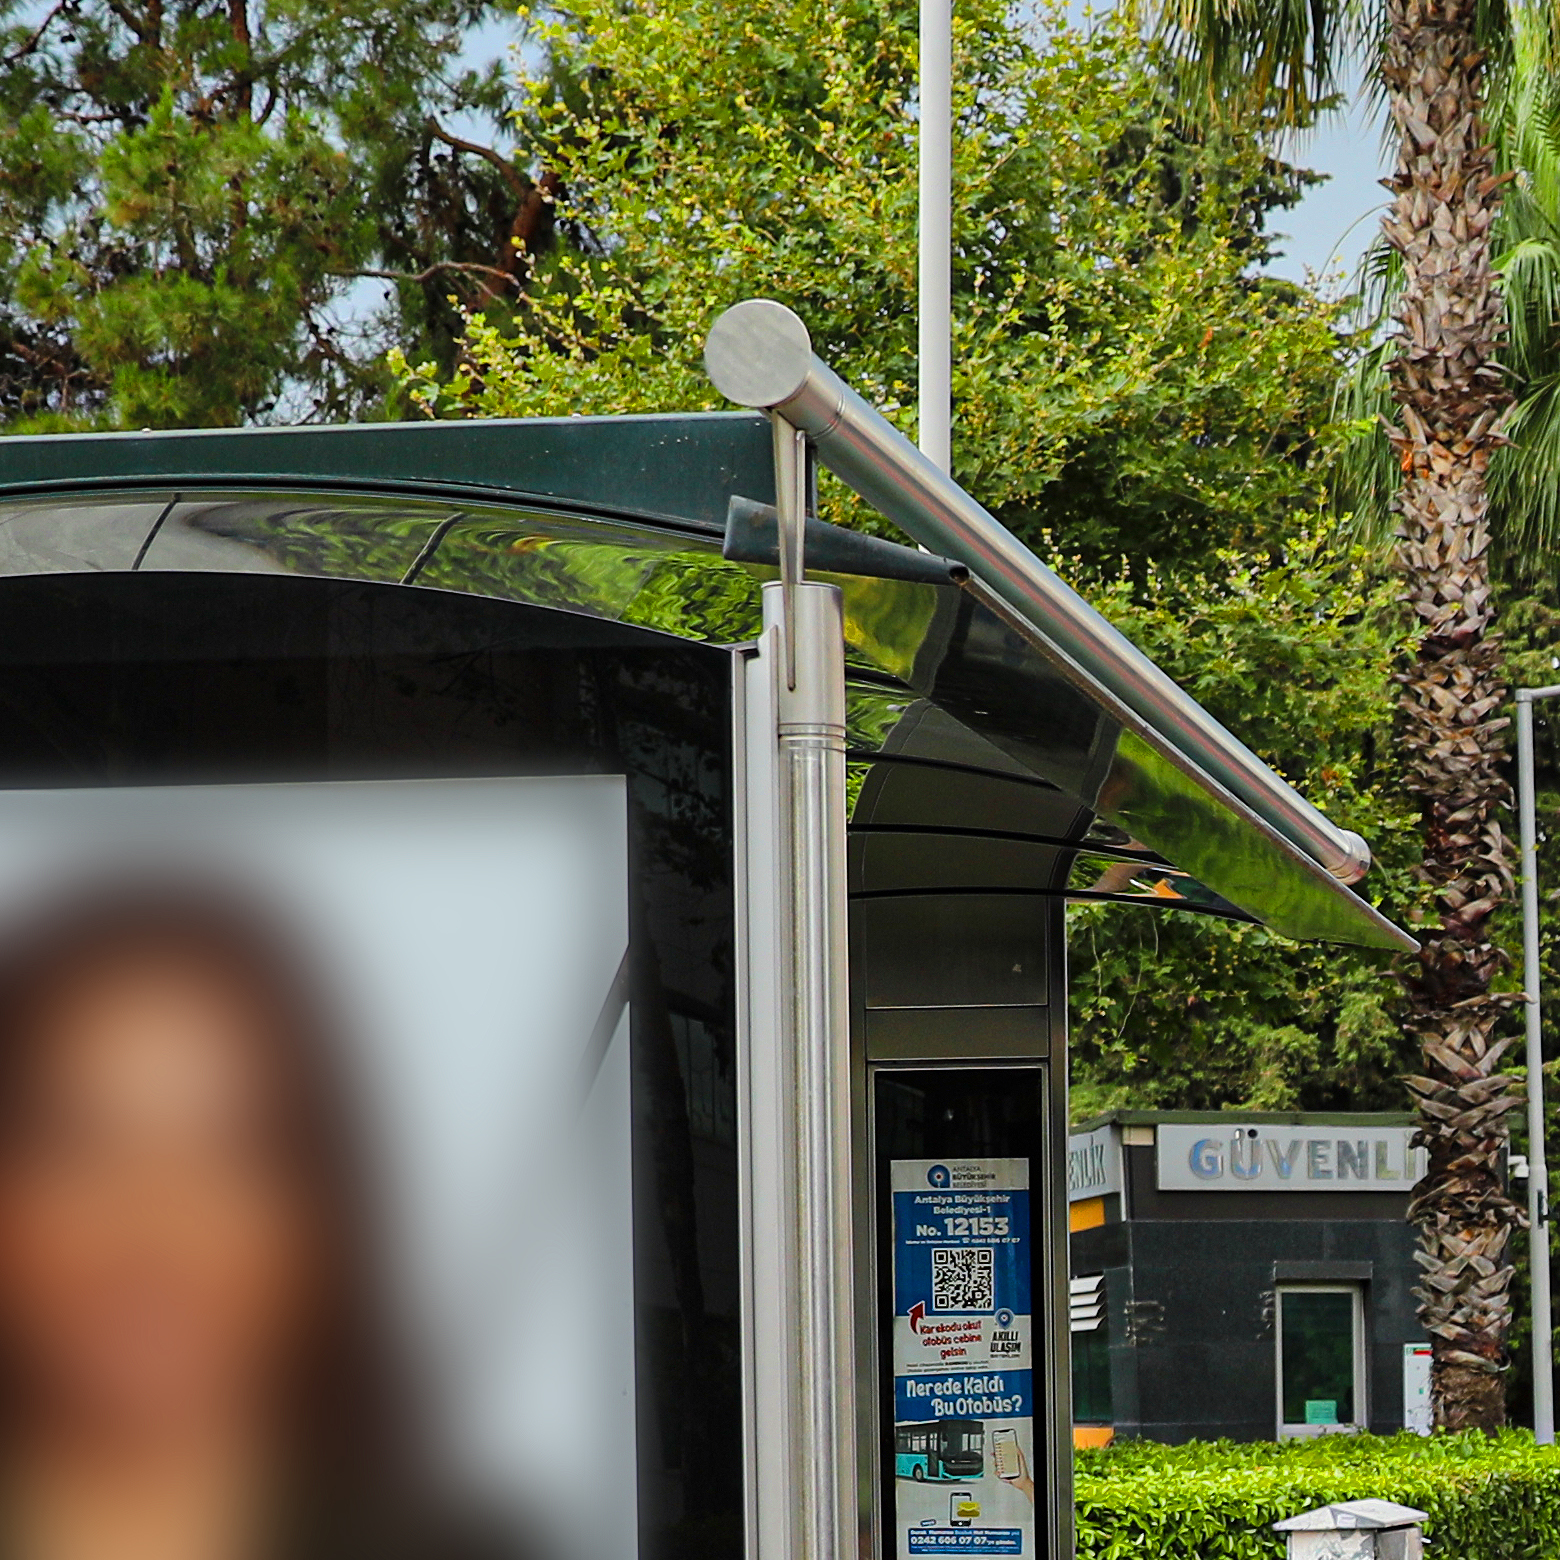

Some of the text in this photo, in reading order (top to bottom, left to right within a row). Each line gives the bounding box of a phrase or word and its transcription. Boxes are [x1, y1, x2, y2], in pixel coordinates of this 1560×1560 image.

[914, 1194, 1011, 1204] Antalya Büyükşehir
[916, 1217, 1009, 1237] No. 12153
[964, 1376, 1005, 1396] Kaldı
[931, 1395, 1023, 1417] Bu Otobüs?
